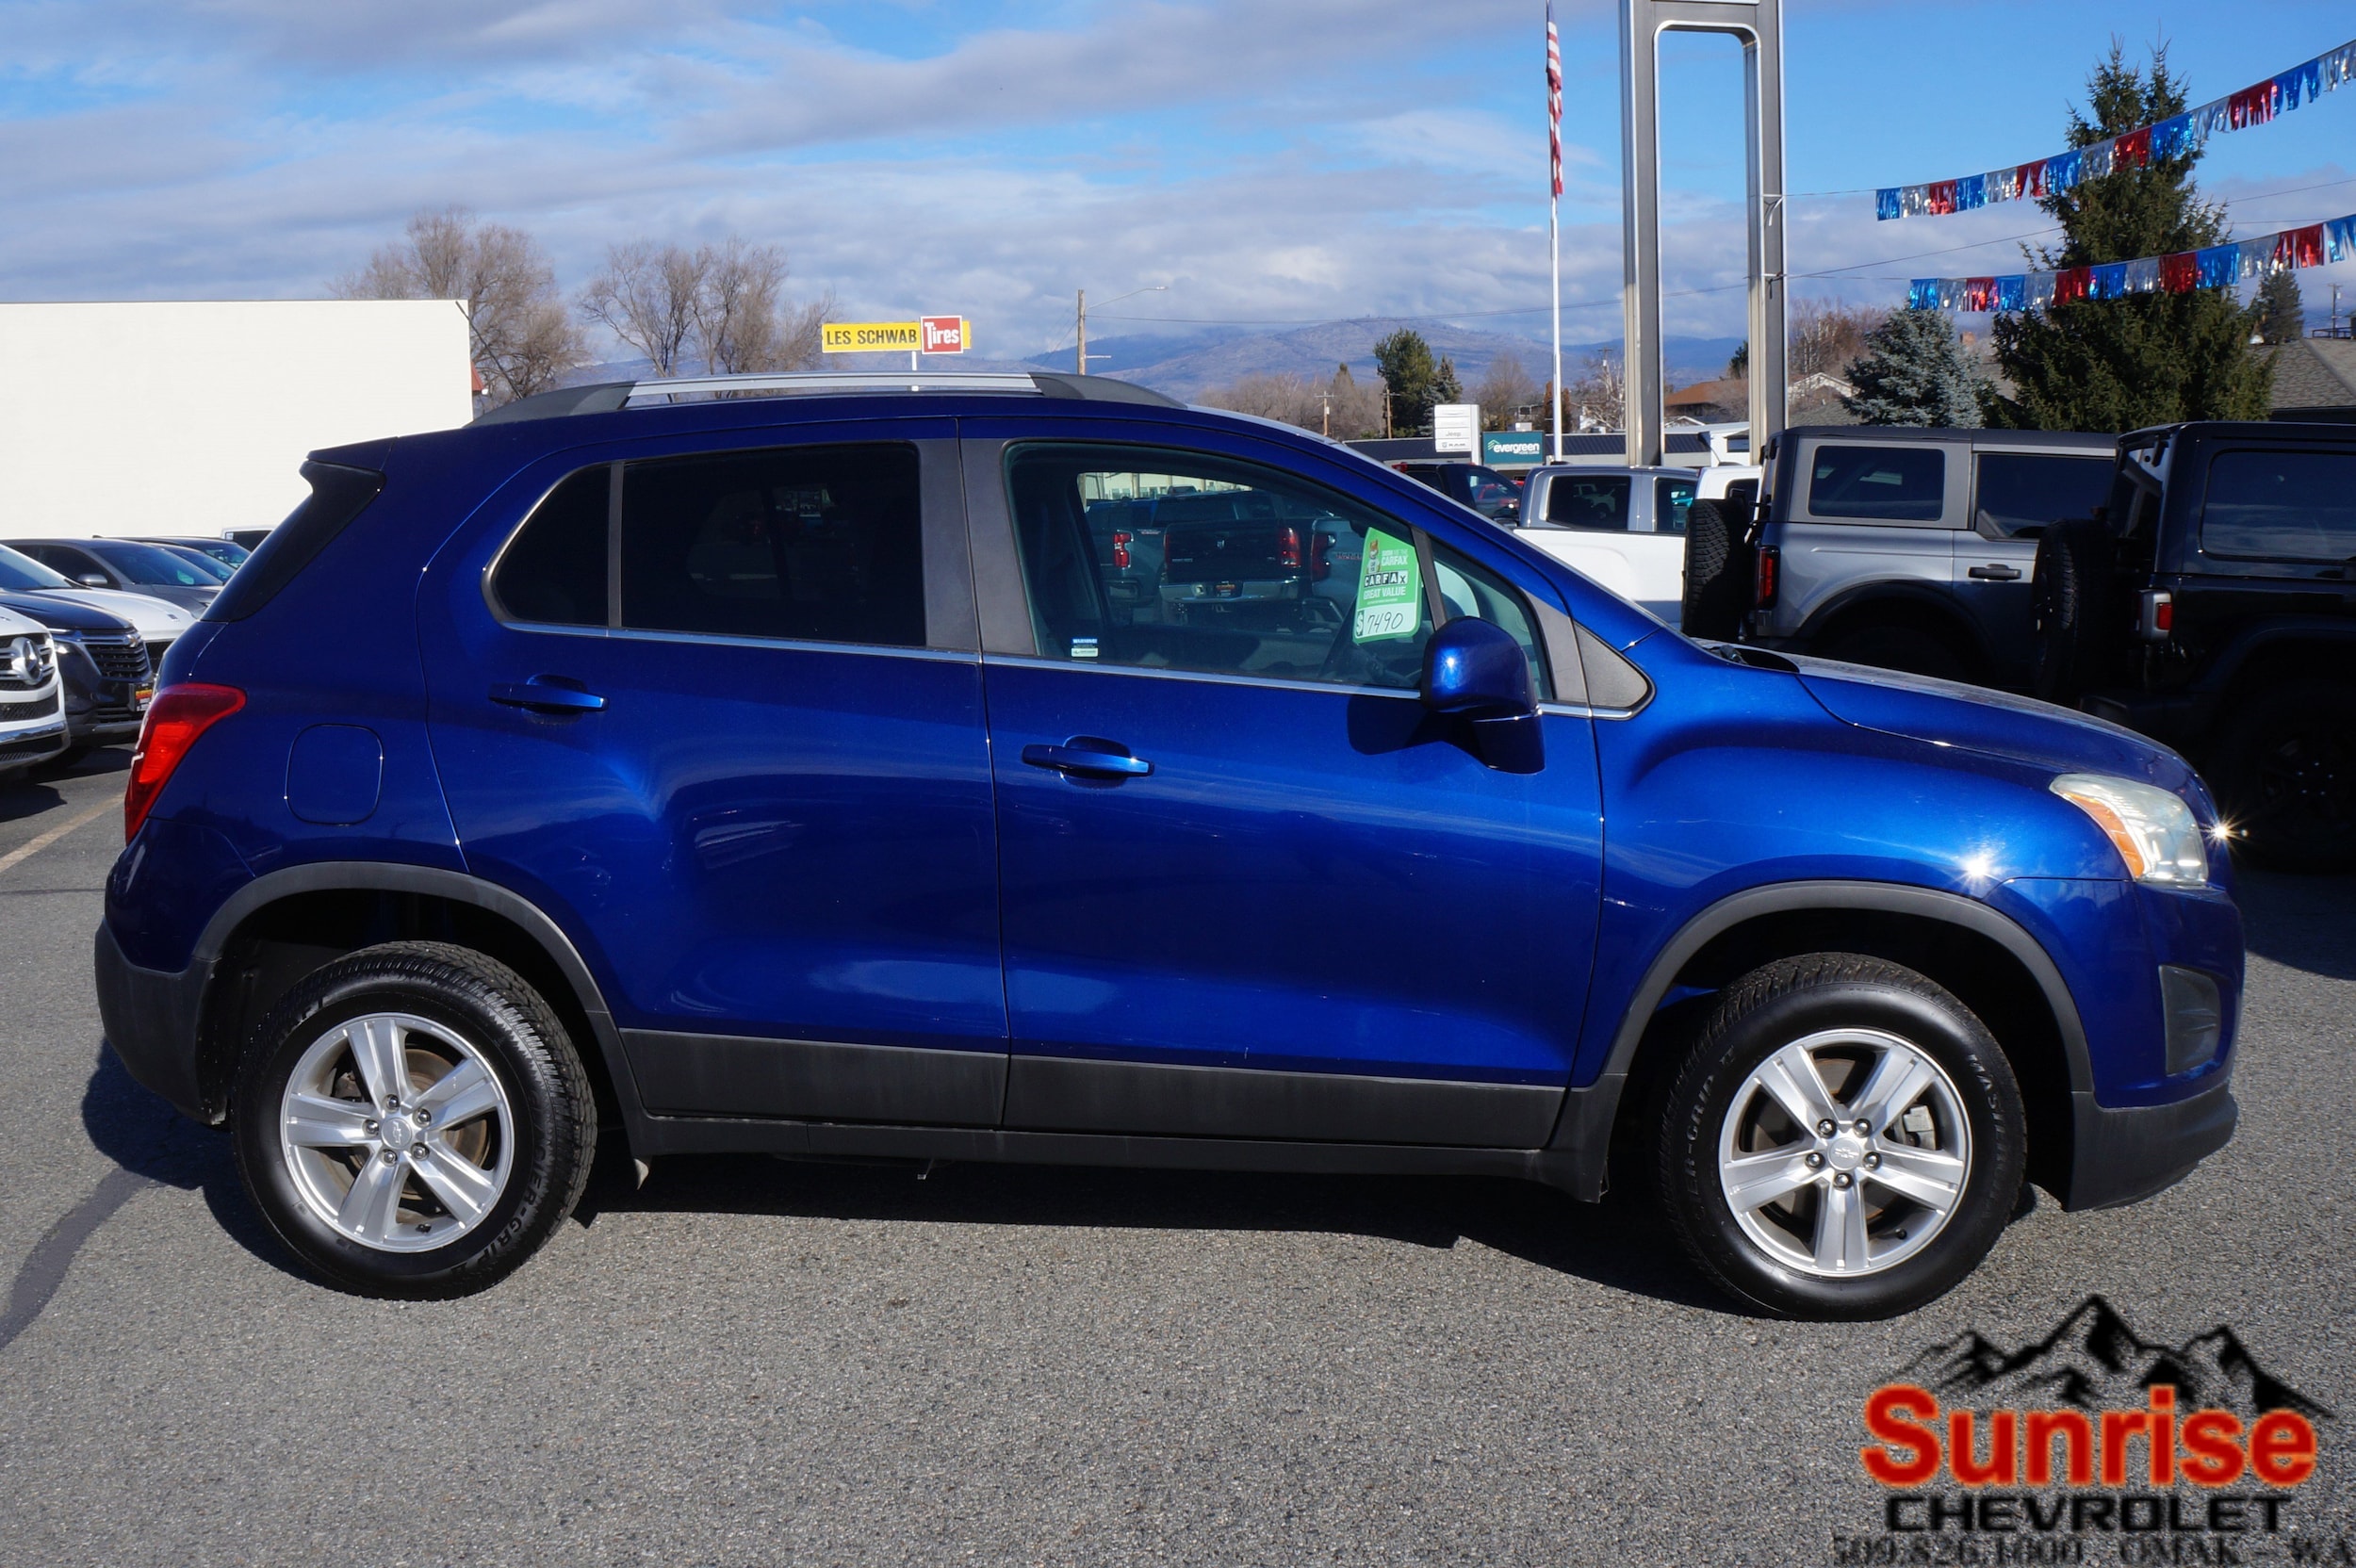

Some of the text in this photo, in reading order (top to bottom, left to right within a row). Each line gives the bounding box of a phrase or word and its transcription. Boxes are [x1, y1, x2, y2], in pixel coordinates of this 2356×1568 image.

[826, 321, 959, 350] LES SCHWAB Tires
[1493, 443, 1540, 454] evergreen
[1381, 555, 1408, 566] CARFAX
[1364, 571, 1407, 587] CARFAX
[1382, 586, 1406, 596] VALUE
